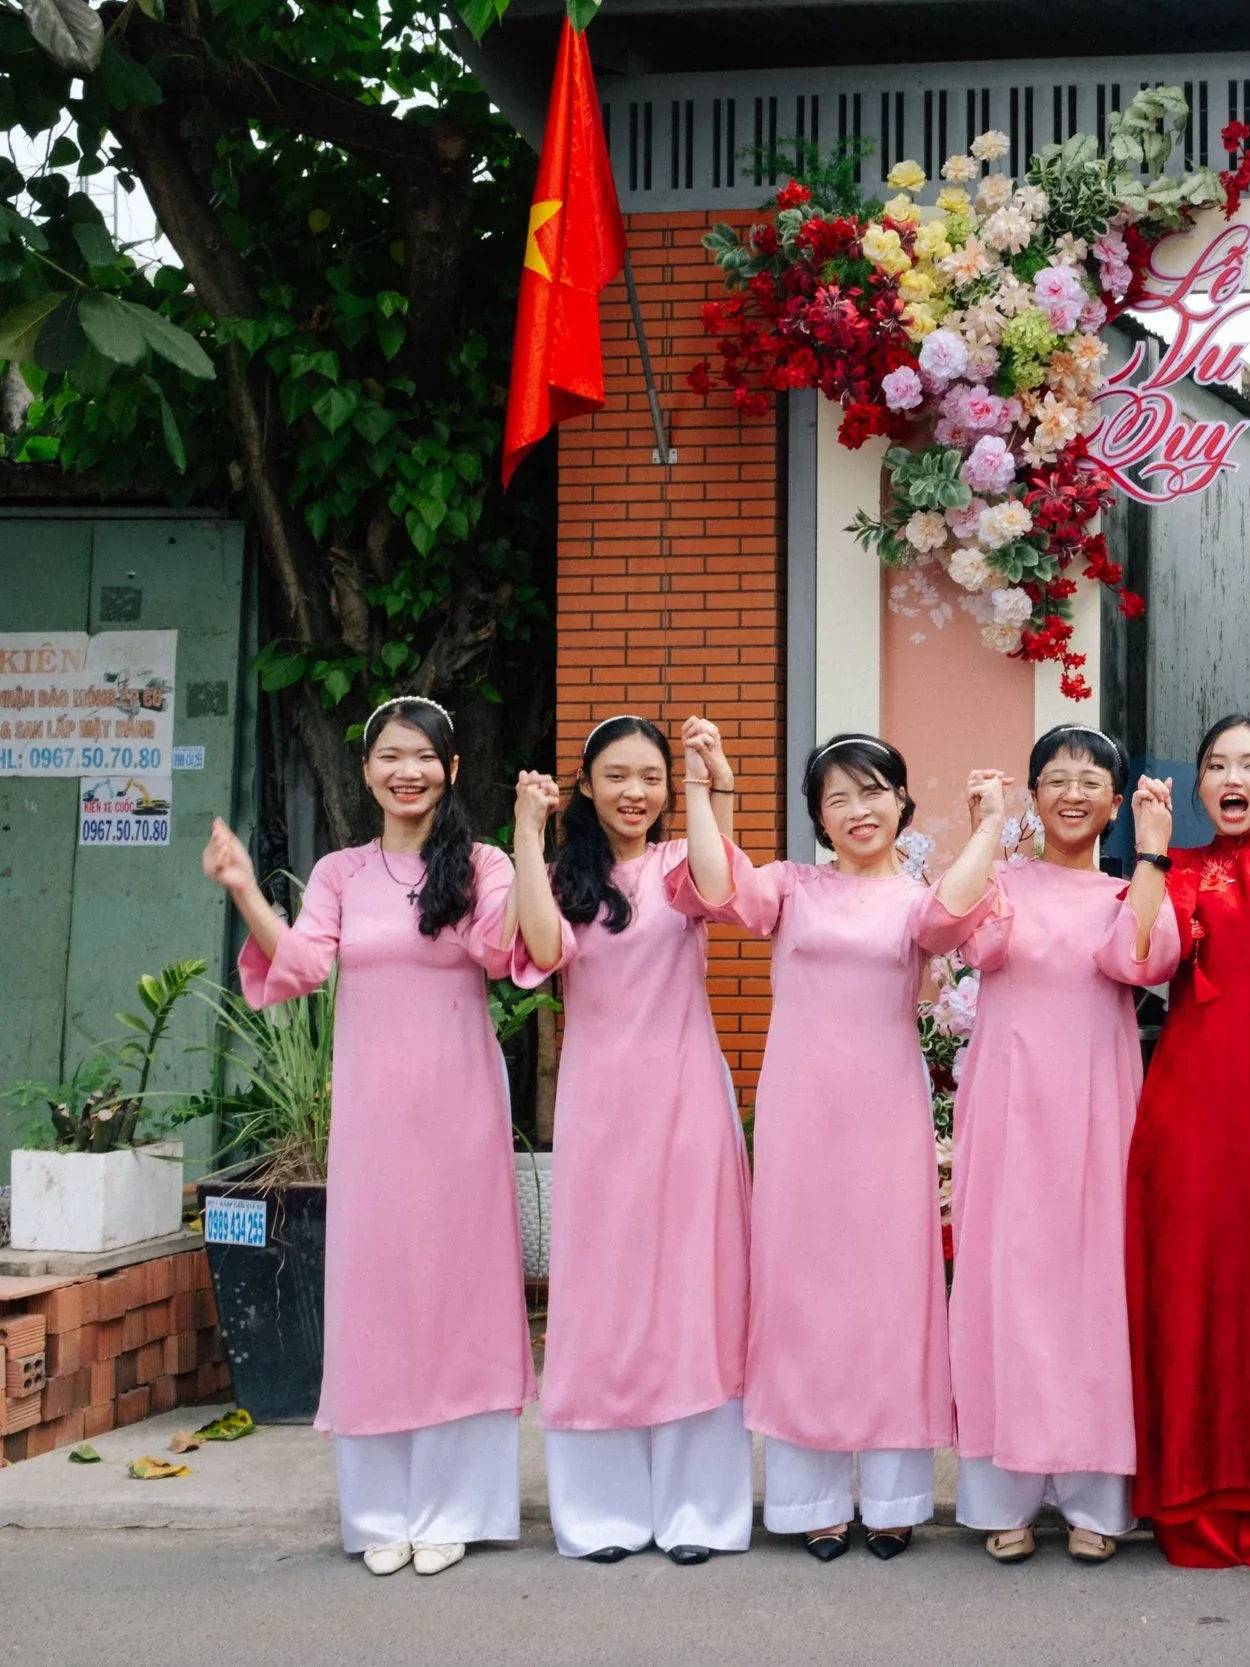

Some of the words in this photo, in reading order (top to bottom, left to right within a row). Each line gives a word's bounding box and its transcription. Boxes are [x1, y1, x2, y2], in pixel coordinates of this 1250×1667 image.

[1080, 388, 1250, 504] Quy
[30, 747, 161, 769] 0967.50.70.80
[104, 802, 112, 813] XE
[83, 820, 167, 841] 0967.50.70.80
[208, 1209, 229, 1241] 0989
[230, 1210, 247, 1242] 434
[248, 1212, 263, 1244] 255
